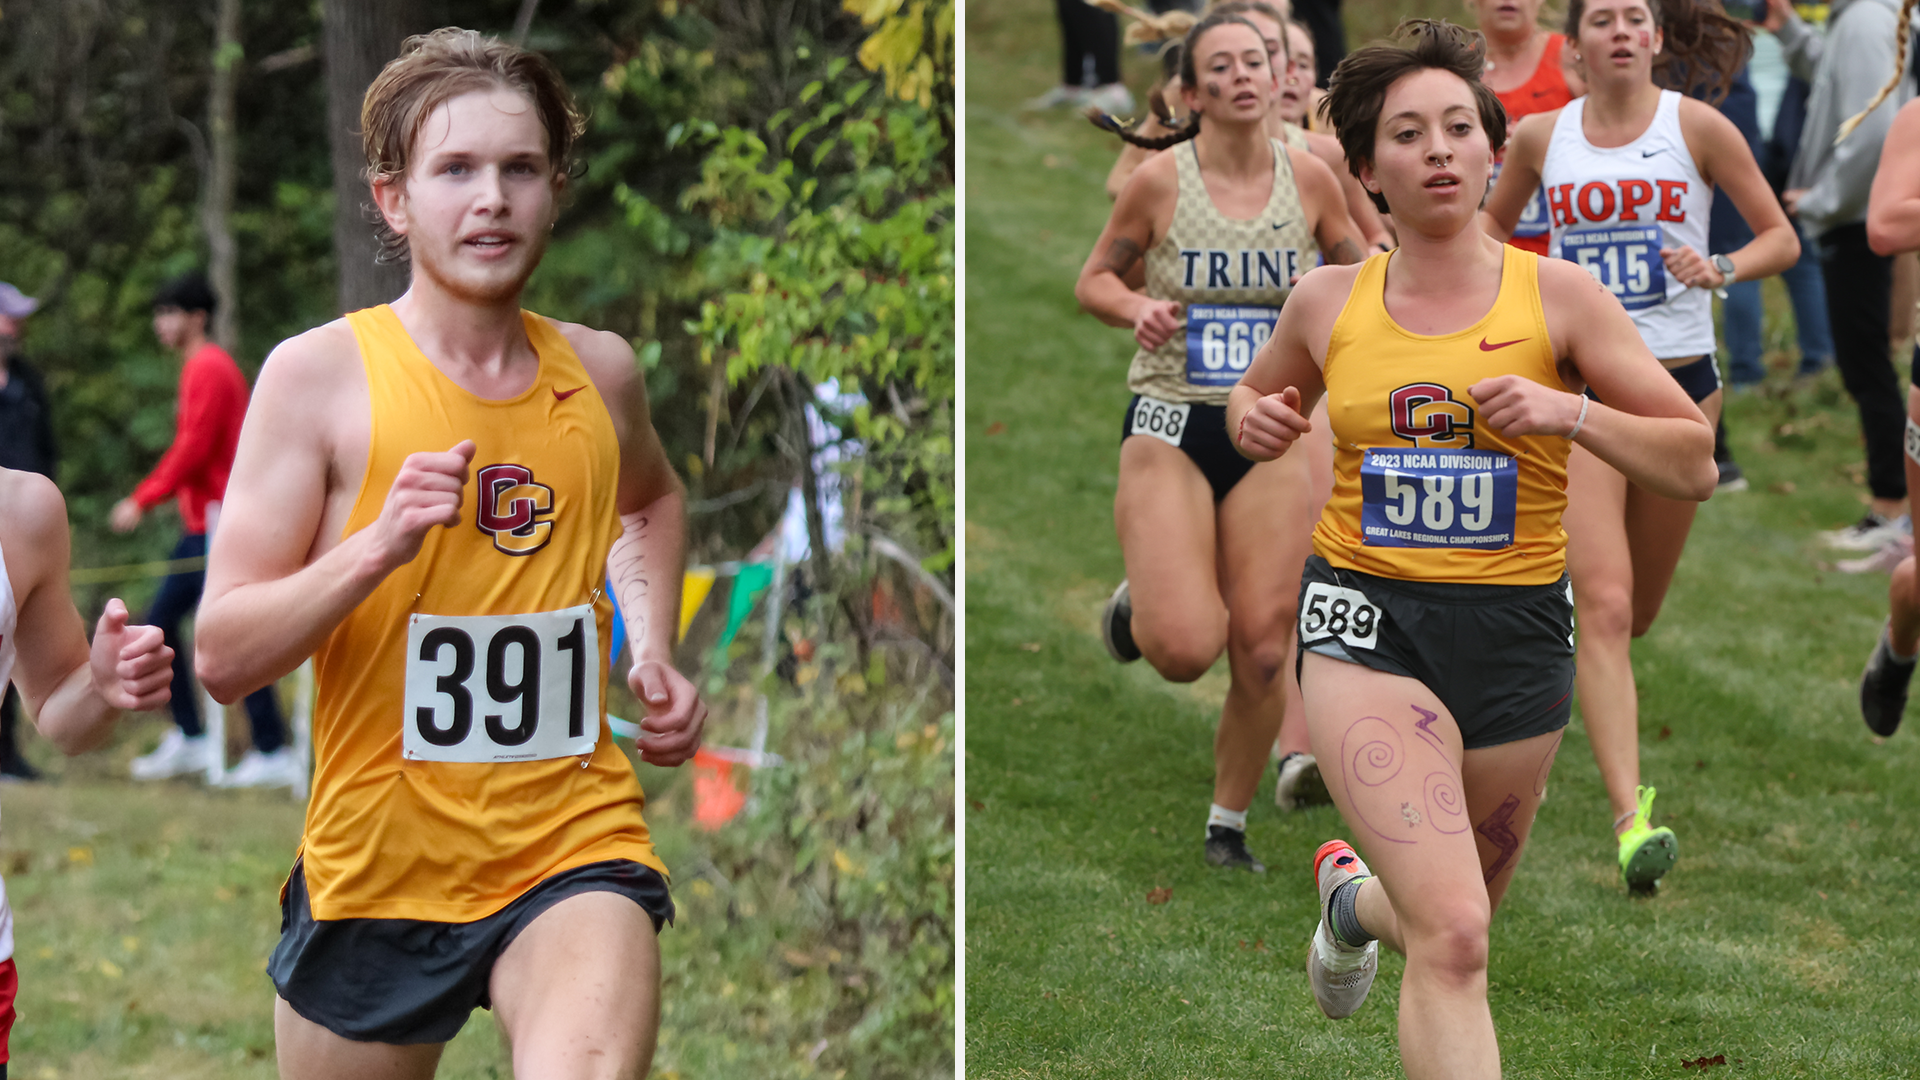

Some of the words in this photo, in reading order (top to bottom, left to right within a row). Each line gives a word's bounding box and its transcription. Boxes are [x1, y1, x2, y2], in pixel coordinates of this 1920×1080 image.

[1548, 179, 1688, 228] HOPE
[1577, 244, 1650, 294] 515
[1136, 401, 1183, 437] 668
[1371, 454, 1401, 468] 2023
[1402, 454, 1437, 469] NCAA
[1439, 455, 1492, 470] DIVISION
[1495, 456, 1508, 469] III
[1384, 468, 1493, 531] 589
[1365, 526, 1389, 537] GREAT
[1389, 529, 1412, 541] LAKES
[1412, 532, 1449, 544] REGIONAL
[1449, 533, 1510, 544] CHAMPIONSHIPS
[1305, 593, 1375, 639] 589
[416, 617, 587, 747] 391
